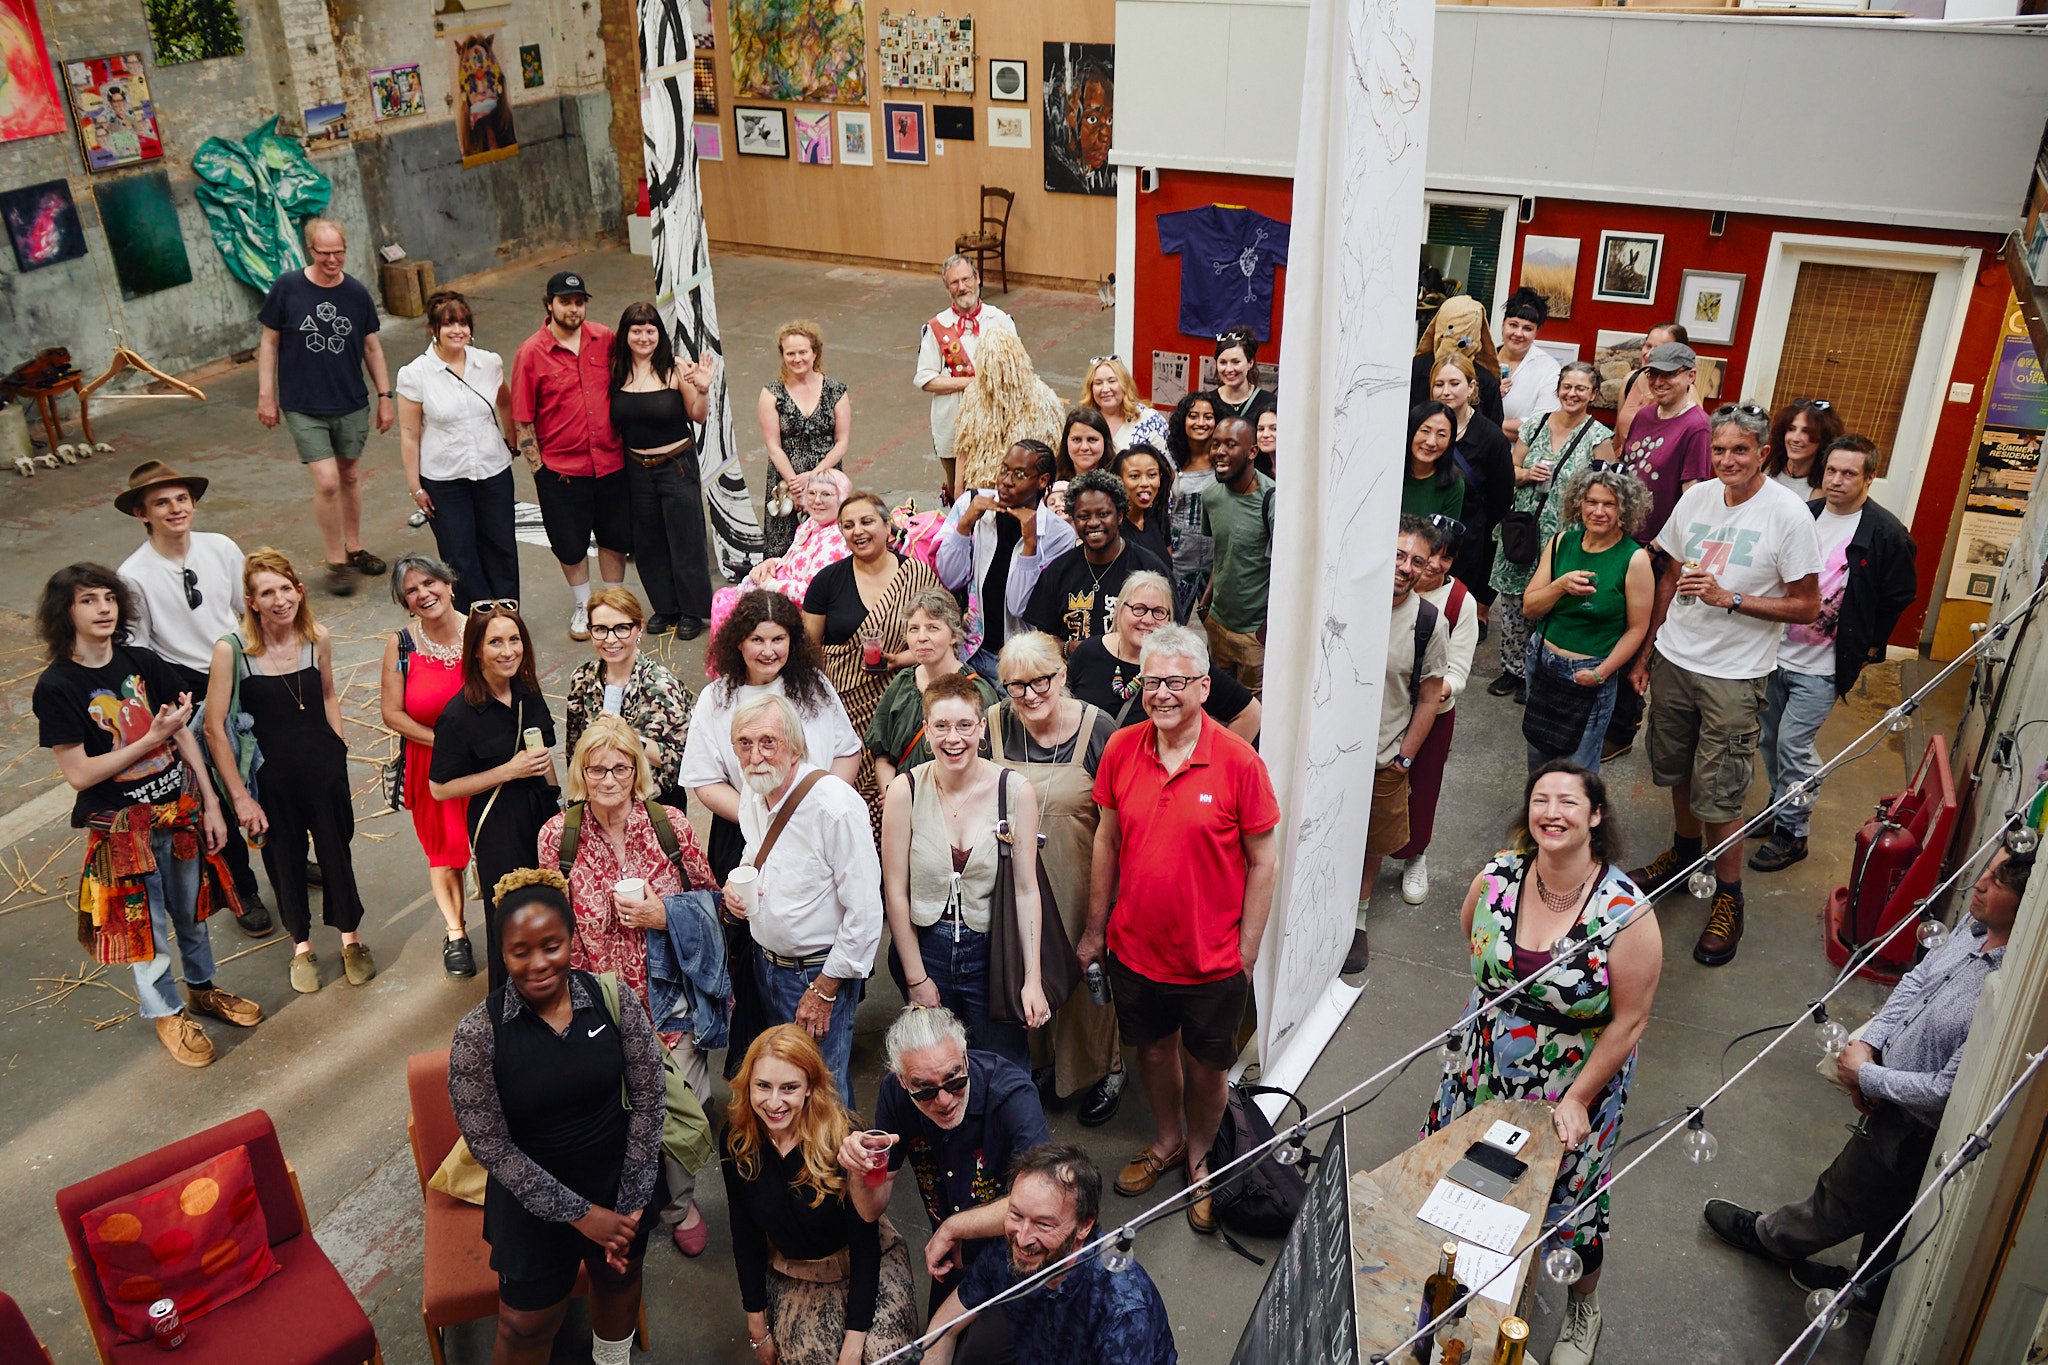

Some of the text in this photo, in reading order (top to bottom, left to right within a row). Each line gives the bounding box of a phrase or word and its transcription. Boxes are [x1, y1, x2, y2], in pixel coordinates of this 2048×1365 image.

[2016, 374, 2047, 385] OVER
[1996, 443, 2035, 454] SUMMER
[1989, 449, 2039, 461] RESIDENCY
[1325, 1145, 1347, 1303] OVADA
